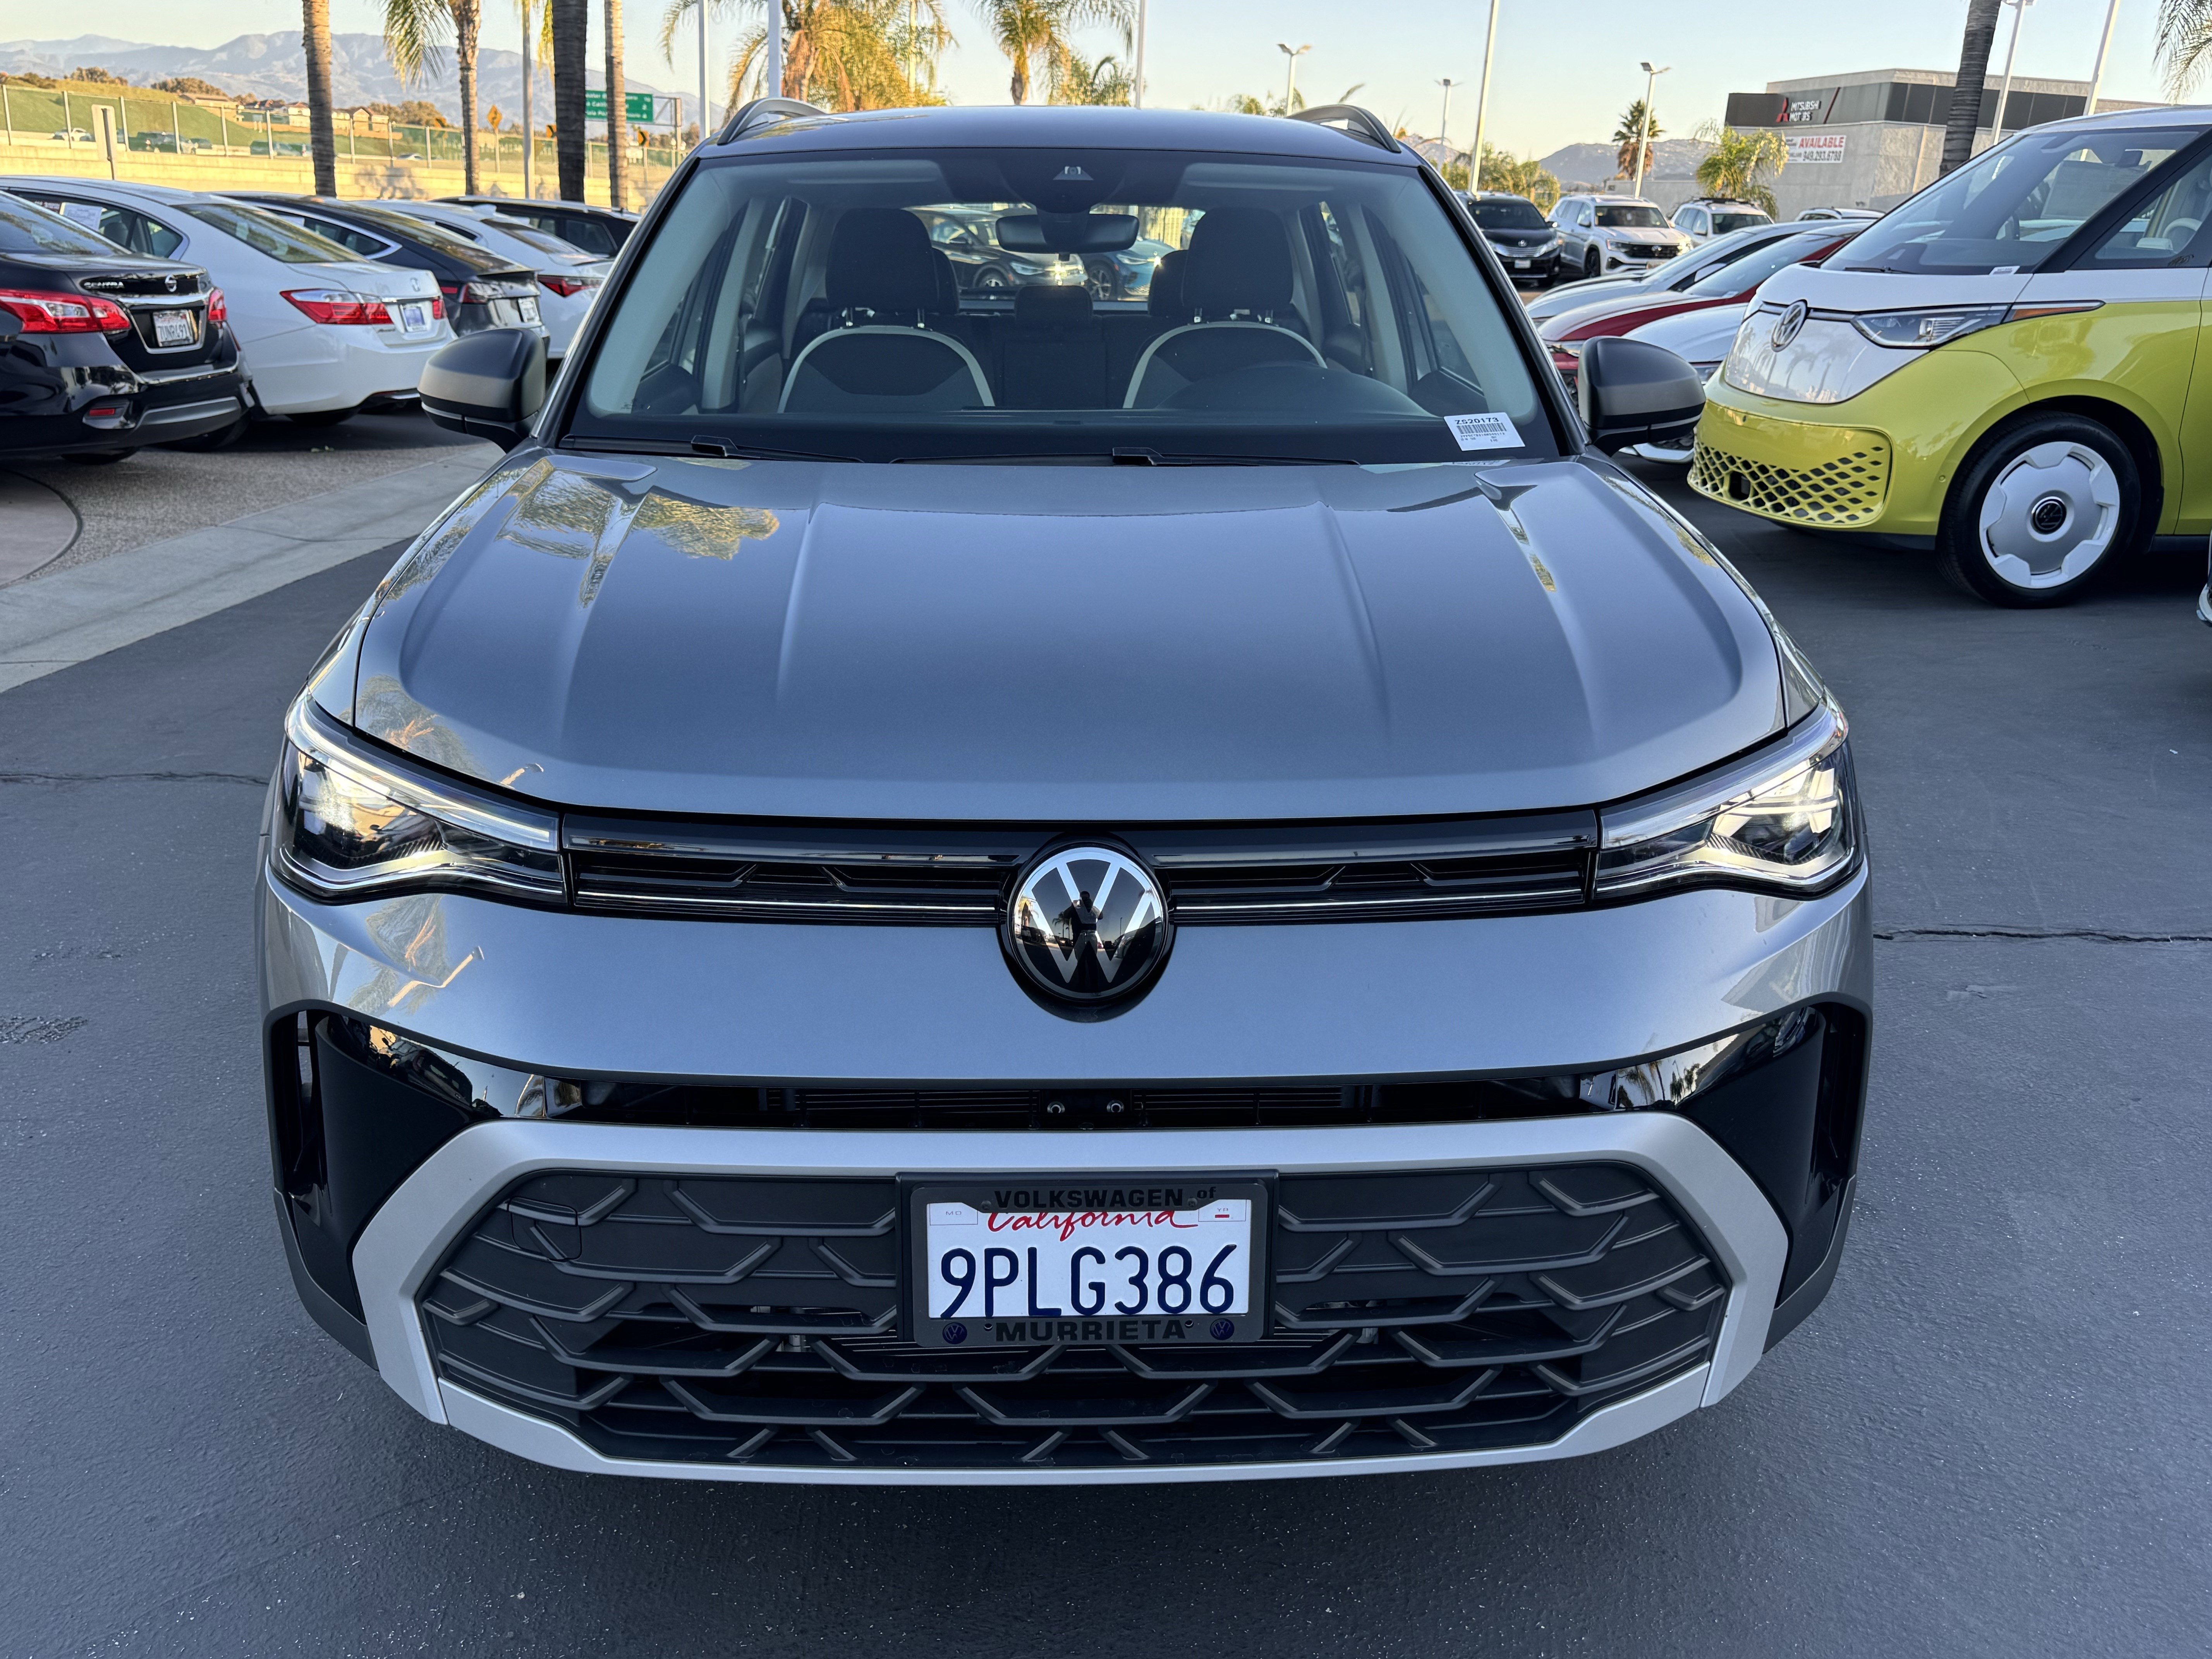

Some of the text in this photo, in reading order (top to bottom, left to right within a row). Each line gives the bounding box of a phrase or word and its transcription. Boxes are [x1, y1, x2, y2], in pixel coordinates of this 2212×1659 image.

[1798, 137, 1844, 148] AVAILABLE
[994, 1187, 1216, 1208] VOLKSWAGEN of
[940, 1243, 1237, 1318] 9PLG386
[995, 1319, 1187, 1341] MURRIETA
